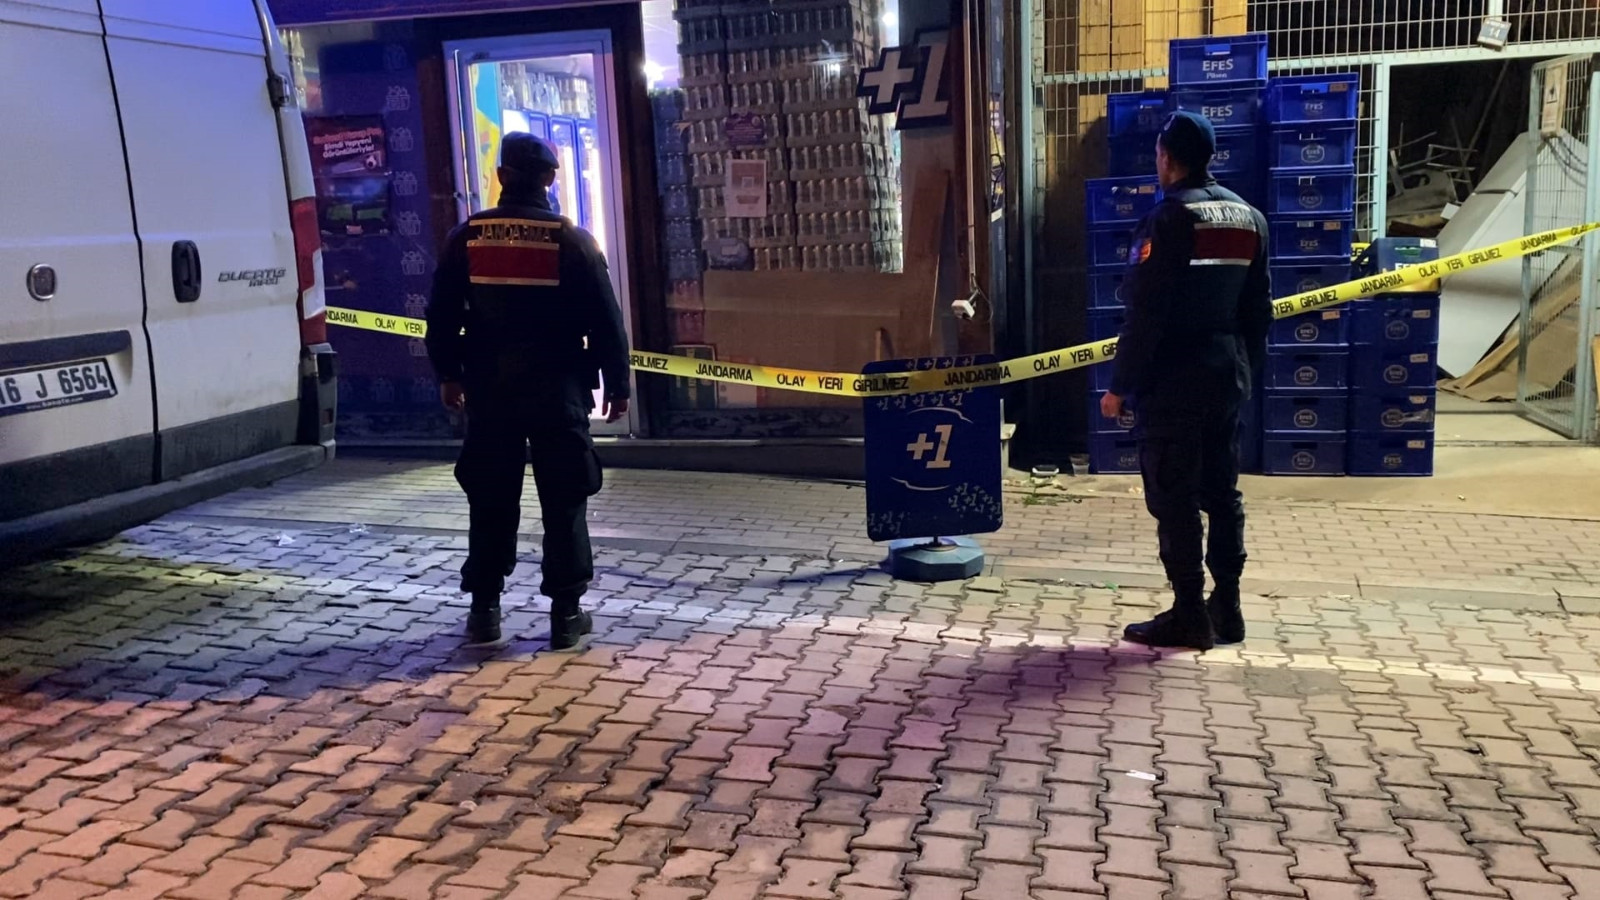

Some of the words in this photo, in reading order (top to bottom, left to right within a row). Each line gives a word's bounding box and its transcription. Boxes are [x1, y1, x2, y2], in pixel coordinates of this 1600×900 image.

[1202, 58, 1234, 72] EFES
[1201, 105, 1233, 117] EFES
[1213, 150, 1230, 161] FES
[476, 224, 552, 242] JANDARMA
[1360, 273, 1404, 294] JANDARMA
[1419, 264, 1440, 278] OLAY
[326, 310, 358, 324] NDARMA
[375, 318, 396, 329] OLAY
[696, 363, 753, 382] JANDARMA
[777, 373, 806, 387] OLAY
[944, 367, 1011, 387] JANDARMA
[1033, 355, 1061, 372] OLAY
[36, 373, 48, 398] J
[57, 364, 108, 395] 6564
[906, 424, 953, 469] +1
